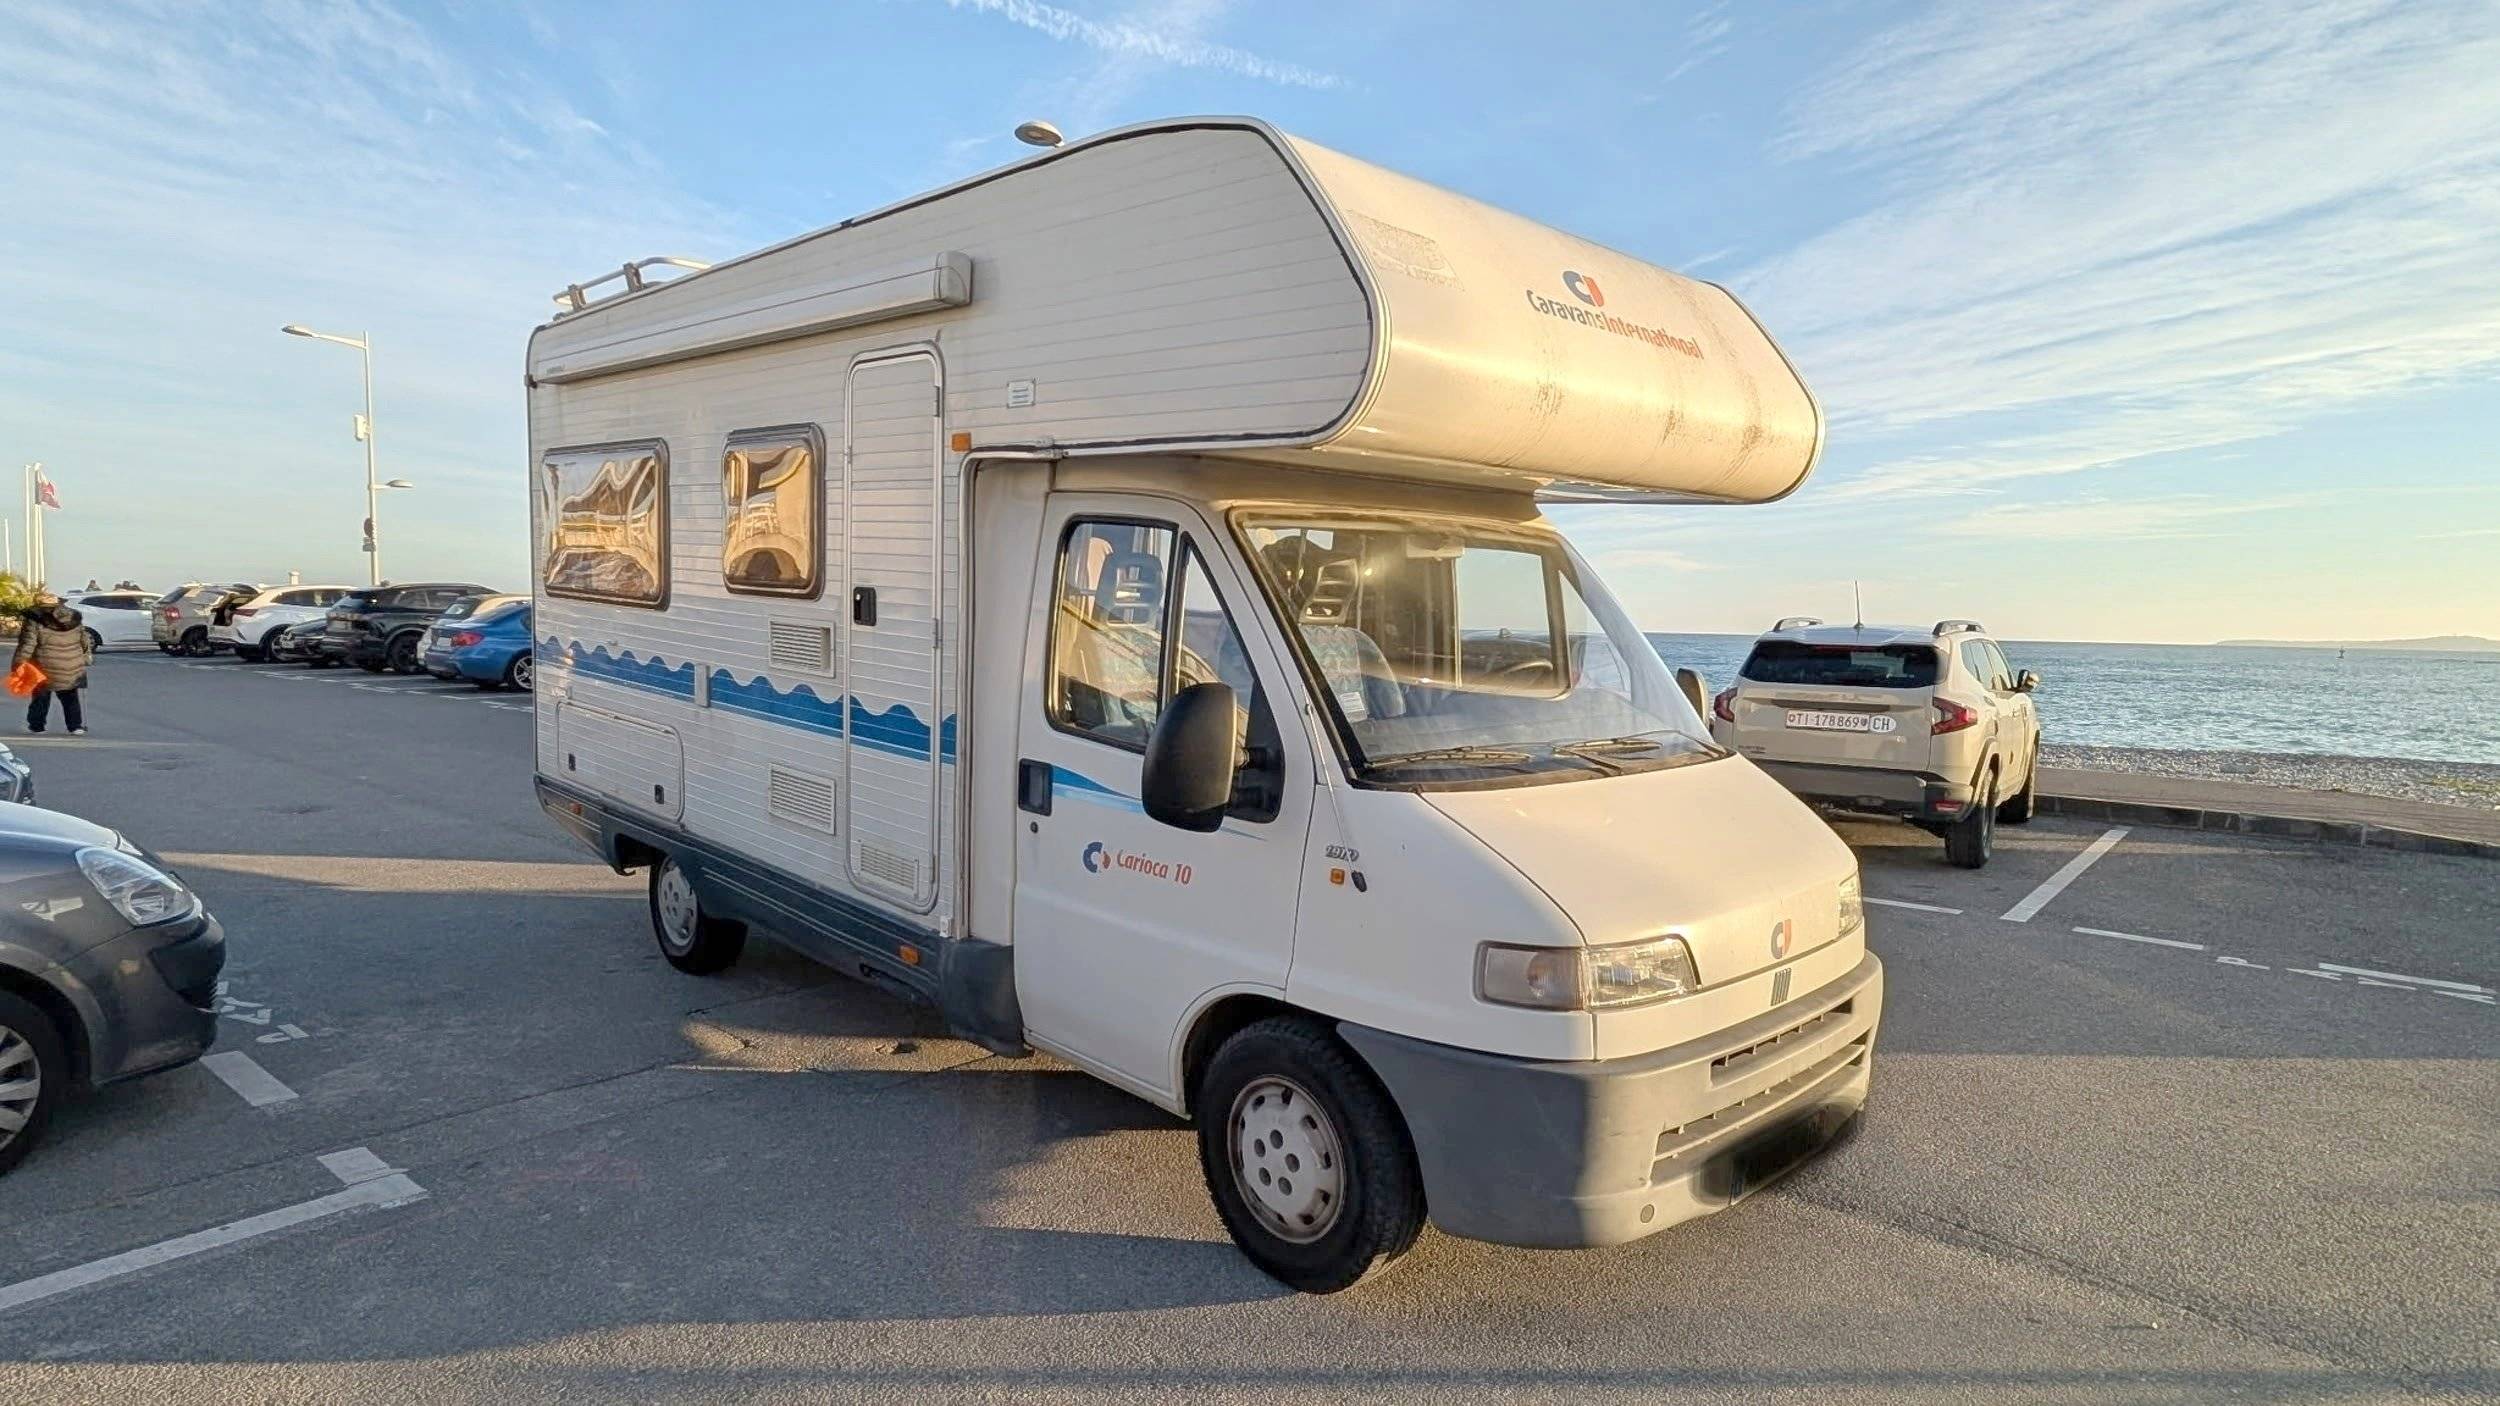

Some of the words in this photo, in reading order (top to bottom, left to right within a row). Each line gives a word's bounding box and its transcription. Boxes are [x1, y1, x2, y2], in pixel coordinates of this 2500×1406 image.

[1872, 717, 1890, 731] CH
[1117, 849, 1168, 879] Carioca
[1174, 863, 1192, 885] 10
